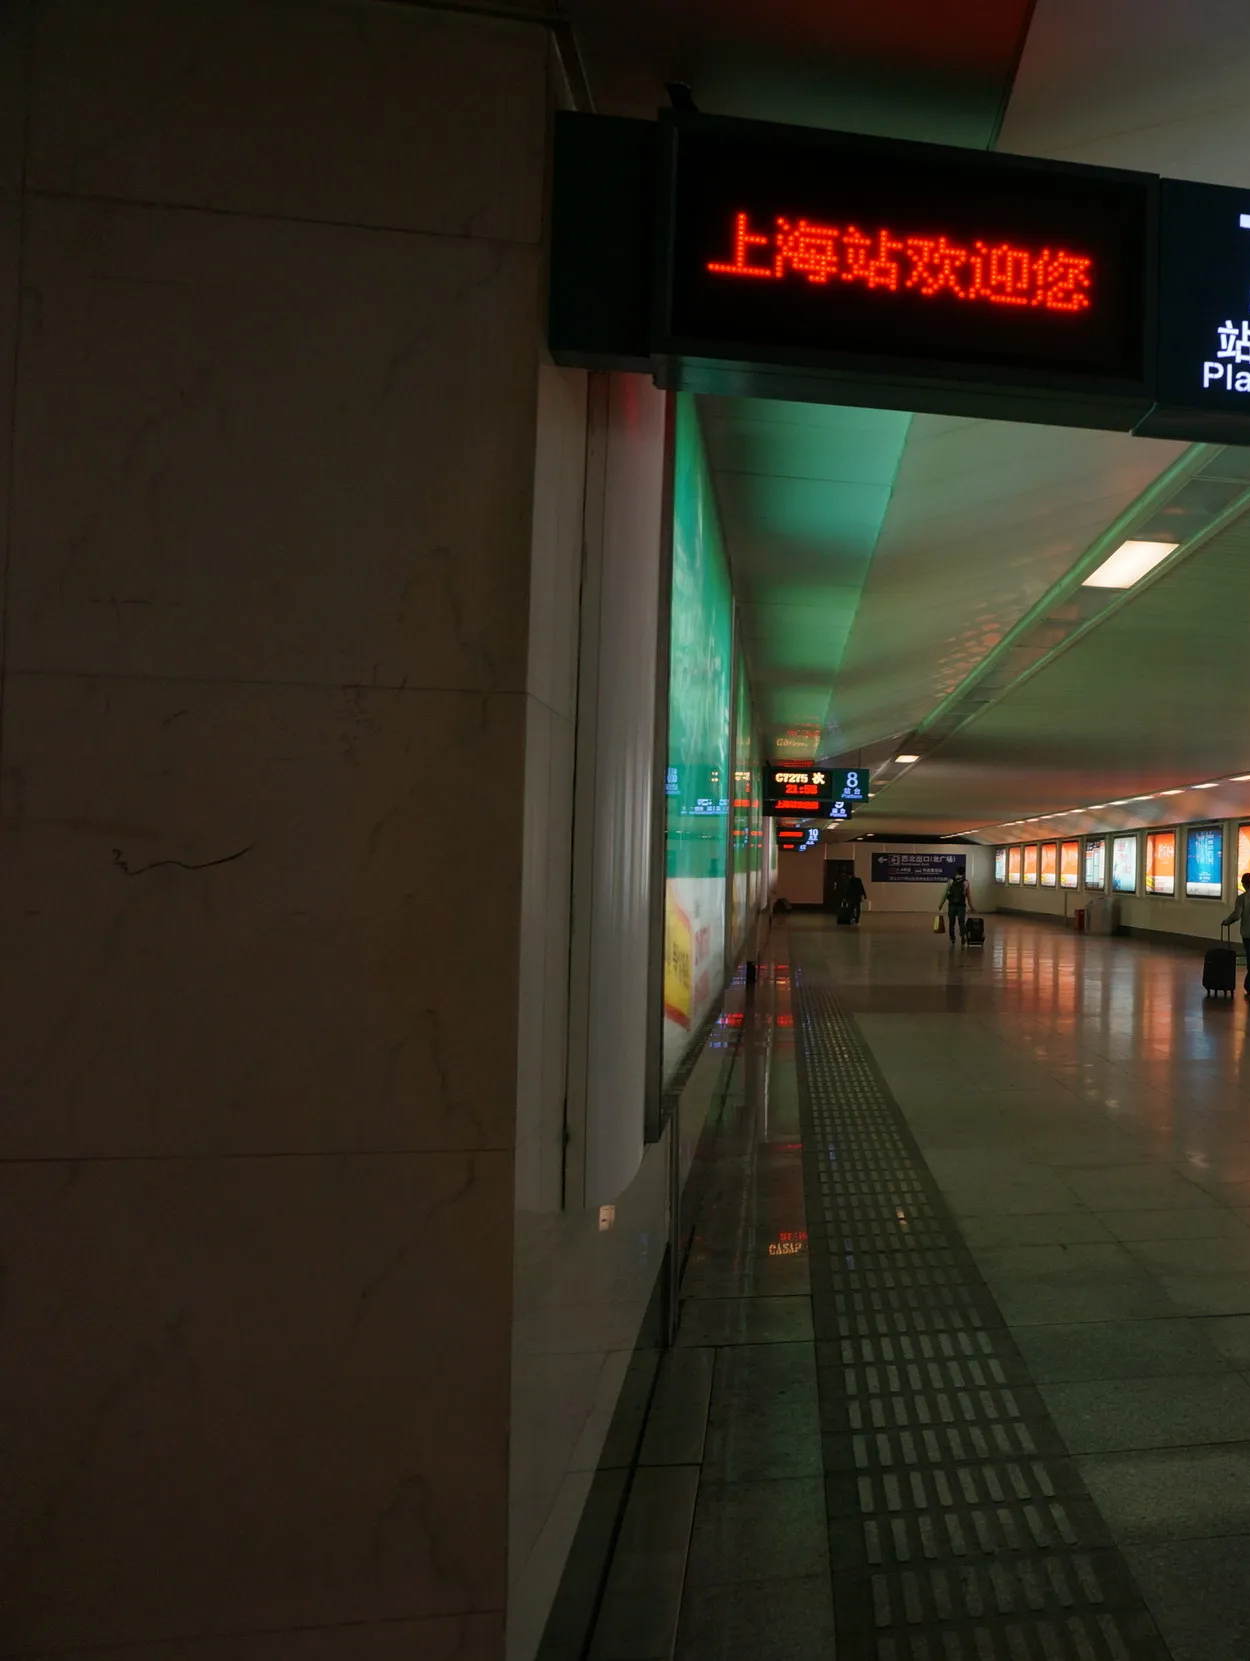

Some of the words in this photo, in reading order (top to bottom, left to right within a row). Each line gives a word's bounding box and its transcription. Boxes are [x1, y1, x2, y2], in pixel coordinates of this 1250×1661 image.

[707, 211, 1091, 311] 上海站欢迎您
[846, 771, 858, 788] 8
